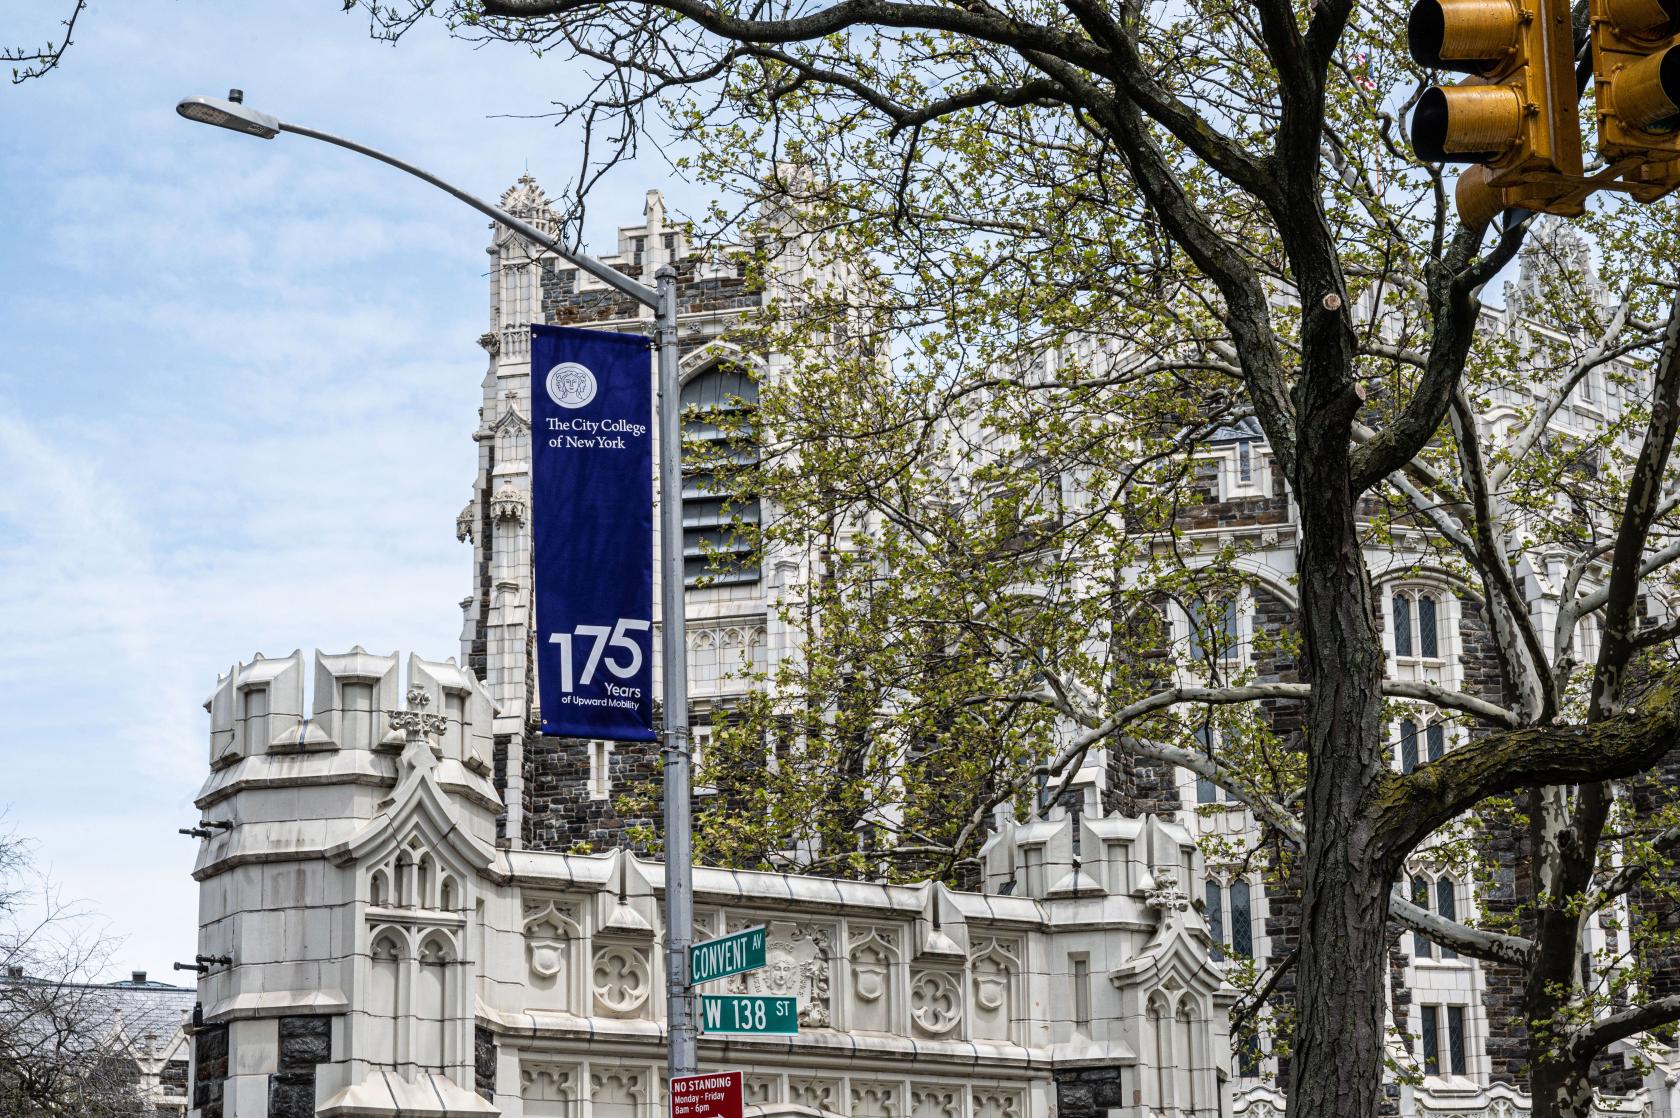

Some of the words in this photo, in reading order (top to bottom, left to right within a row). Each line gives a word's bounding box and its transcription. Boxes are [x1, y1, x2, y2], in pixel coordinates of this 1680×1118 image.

[546, 417, 570, 431] The
[571, 418, 599, 434] City
[601, 419, 646, 437] College
[549, 435, 564, 448] of
[565, 436, 595, 448] New
[597, 436, 626, 449] York
[548, 618, 651, 693] 175
[604, 682, 641, 698] Years
[561, 696, 572, 704] of
[573, 696, 607, 707] Upward
[608, 699, 639, 711] Mobility
[692, 937, 748, 980] CONVENT
[752, 933, 763, 951] AV
[705, 999, 722, 1029] W
[732, 999, 767, 1030] 138
[776, 1001, 790, 1016] ST
[674, 1081, 687, 1093] NO
[688, 1077, 731, 1091] STANDING
[674, 1094, 700, 1104] Monday
[704, 1091, 725, 1101] Friday
[675, 1105, 689, 1115] 8am
[695, 1104, 710, 1113] 6pm
